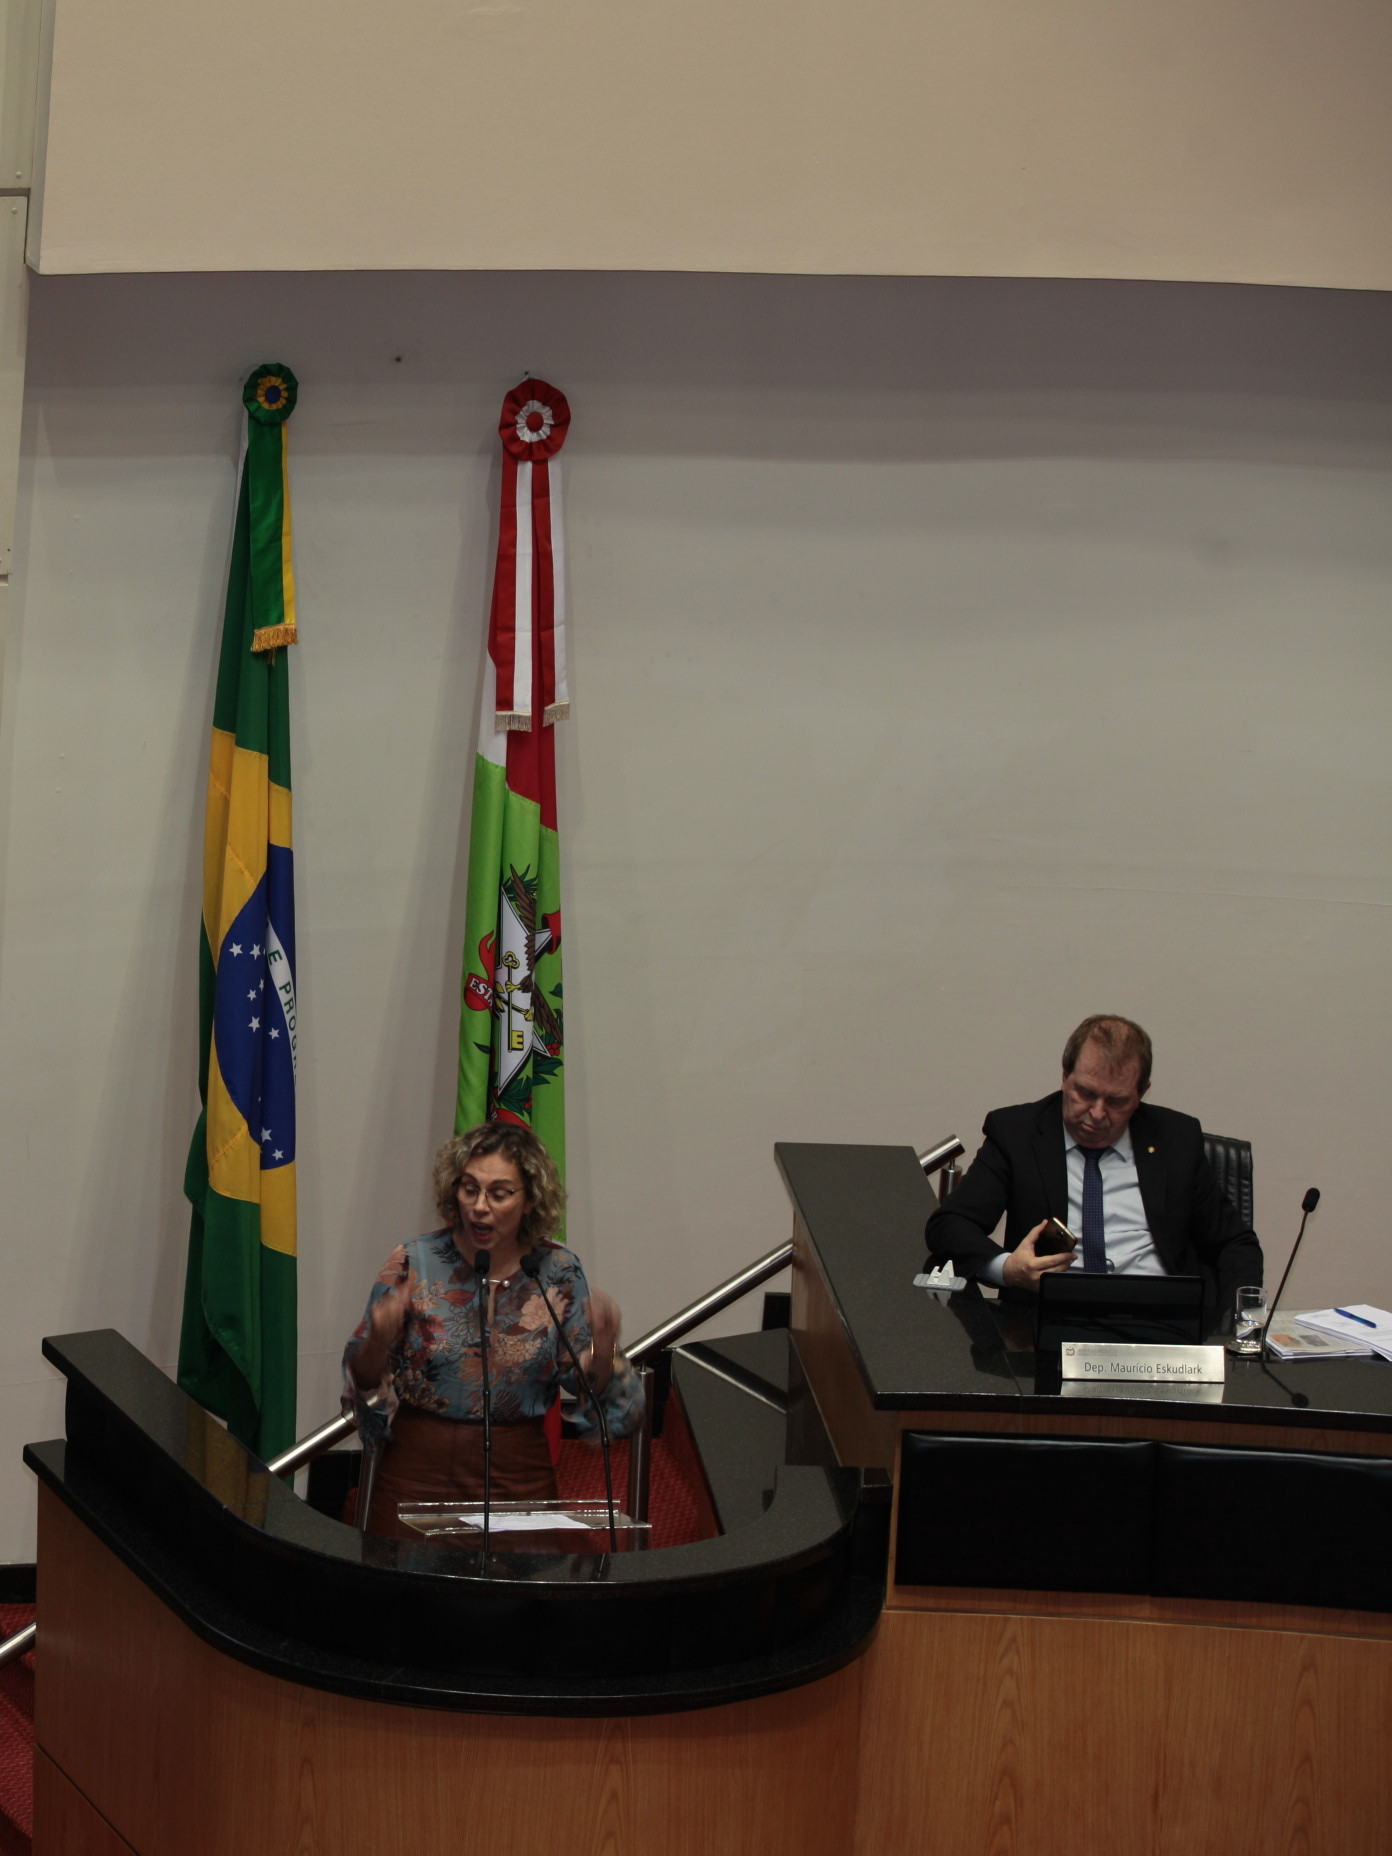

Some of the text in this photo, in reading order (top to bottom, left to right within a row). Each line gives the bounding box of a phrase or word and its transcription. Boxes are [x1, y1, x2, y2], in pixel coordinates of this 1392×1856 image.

[268, 950, 283, 965] E
[1084, 1362, 1203, 1375] Dep. Maurício Eskudlark
